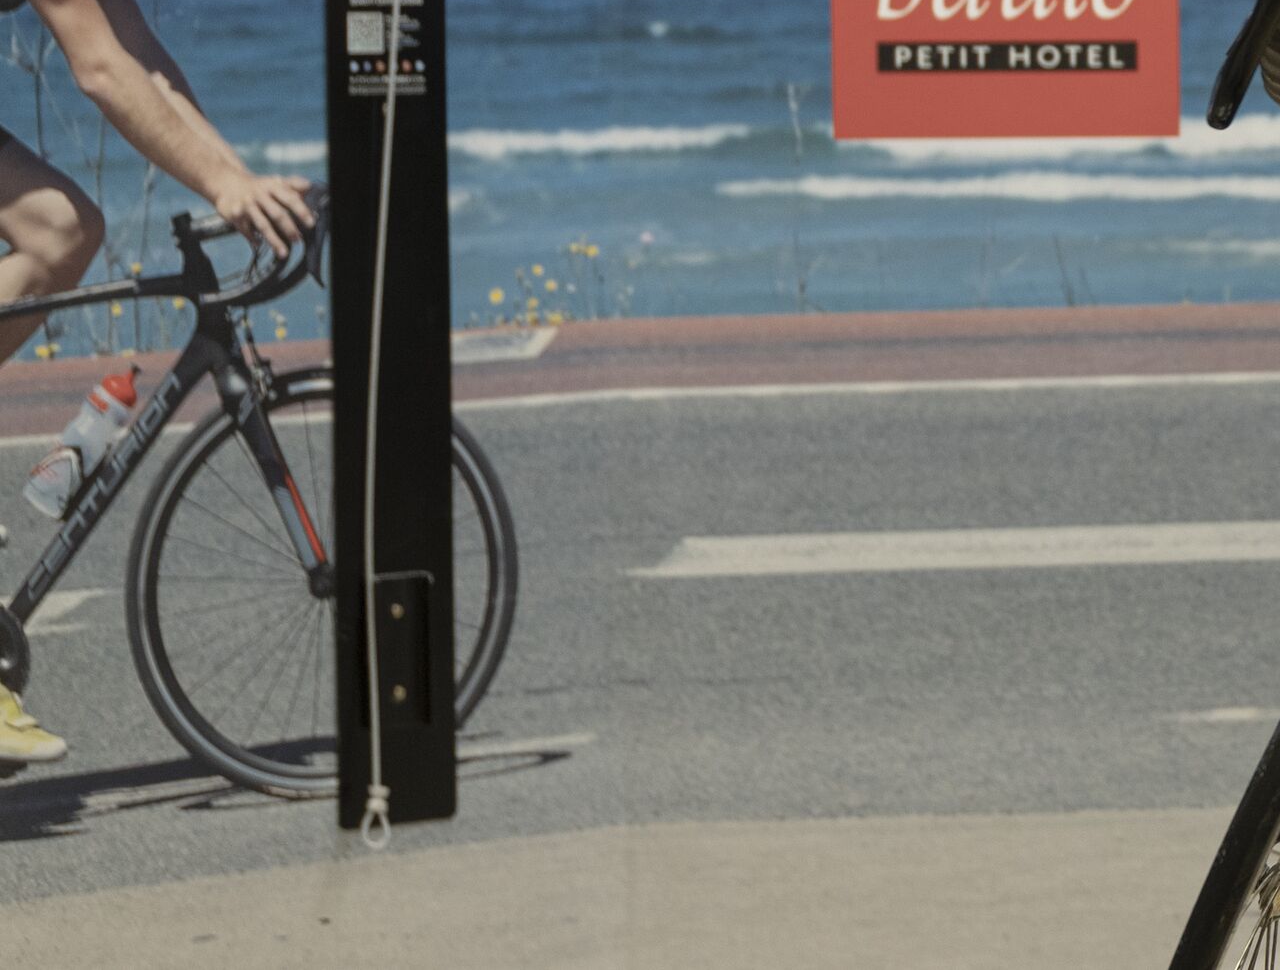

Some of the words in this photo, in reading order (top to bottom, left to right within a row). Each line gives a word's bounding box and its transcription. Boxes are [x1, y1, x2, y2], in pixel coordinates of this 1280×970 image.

[894, 45, 990, 70] PETIT
[1009, 45, 1124, 70] HOTEL
[27, 373, 182, 599] CENTURION
